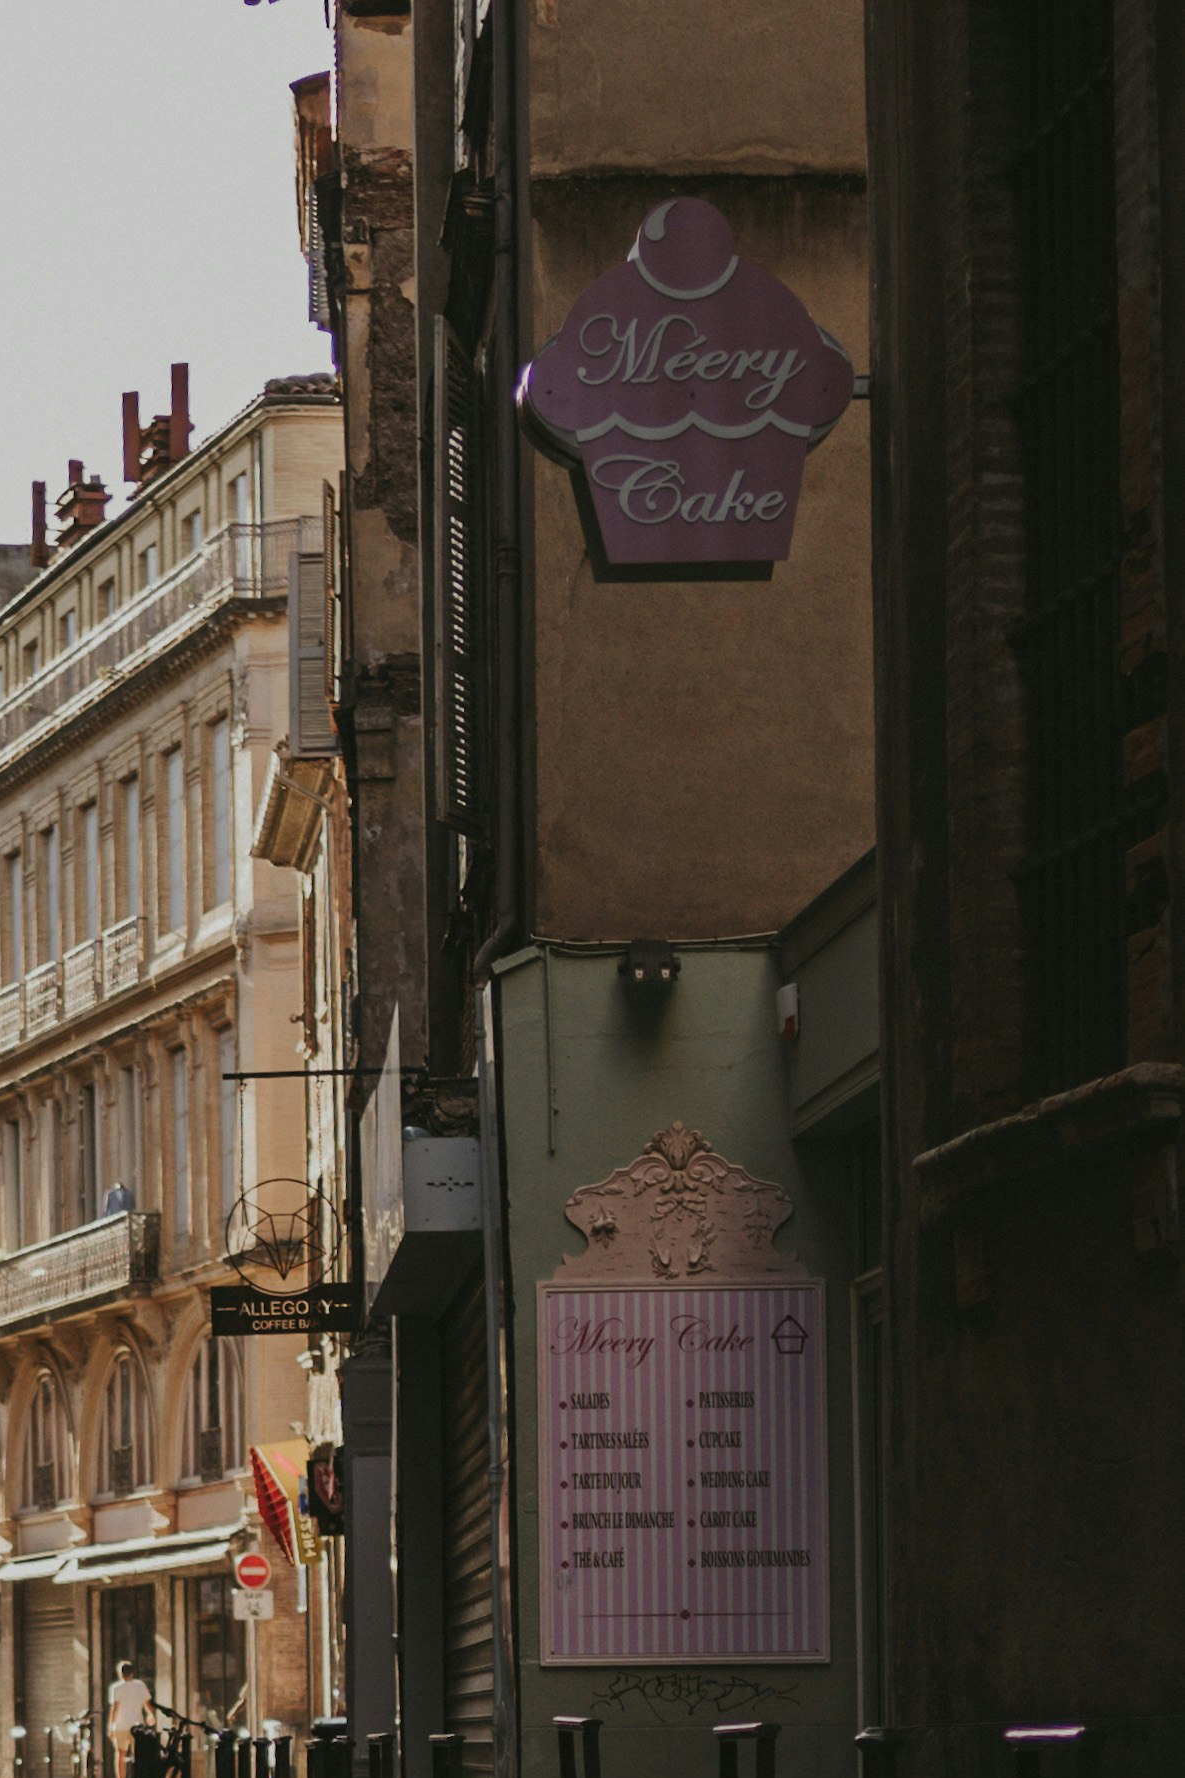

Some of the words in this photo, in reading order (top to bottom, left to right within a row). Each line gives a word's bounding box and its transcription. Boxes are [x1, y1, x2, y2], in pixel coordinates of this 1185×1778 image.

[576, 313, 806, 410] Méery
[590, 454, 787, 524] Cake
[239, 1298, 334, 1317] ALLEGOY
[251, 1319, 296, 1331] COFFEE
[550, 1316, 655, 1370] Meery
[670, 1314, 755, 1354] Cake
[570, 1392, 610, 1410] SALADES
[699, 1391, 755, 1409] PATISSERIES
[571, 1432, 617, 1450] TARTINES
[617, 1429, 649, 1450] SALÉES
[699, 1431, 742, 1449] CUPCAKE
[572, 1472, 602, 1490] TARTE
[603, 1473, 616, 1490] DU
[617, 1472, 642, 1493] JOUR
[700, 1471, 745, 1488] WEDDING
[746, 1471, 771, 1488] CAKE
[572, 1511, 611, 1529] BRUNCH
[613, 1512, 624, 1529] LE
[625, 1511, 675, 1529] DIMANCHE
[700, 1511, 732, 1528] CAROT
[733, 1510, 757, 1528] CAKE
[573, 1547, 592, 1568] THÉ
[593, 1553, 600, 1568] &
[601, 1547, 625, 1568] CAFÉ
[700, 1550, 746, 1568] BOISSONS
[747, 1550, 811, 1568] GOURMANDES
